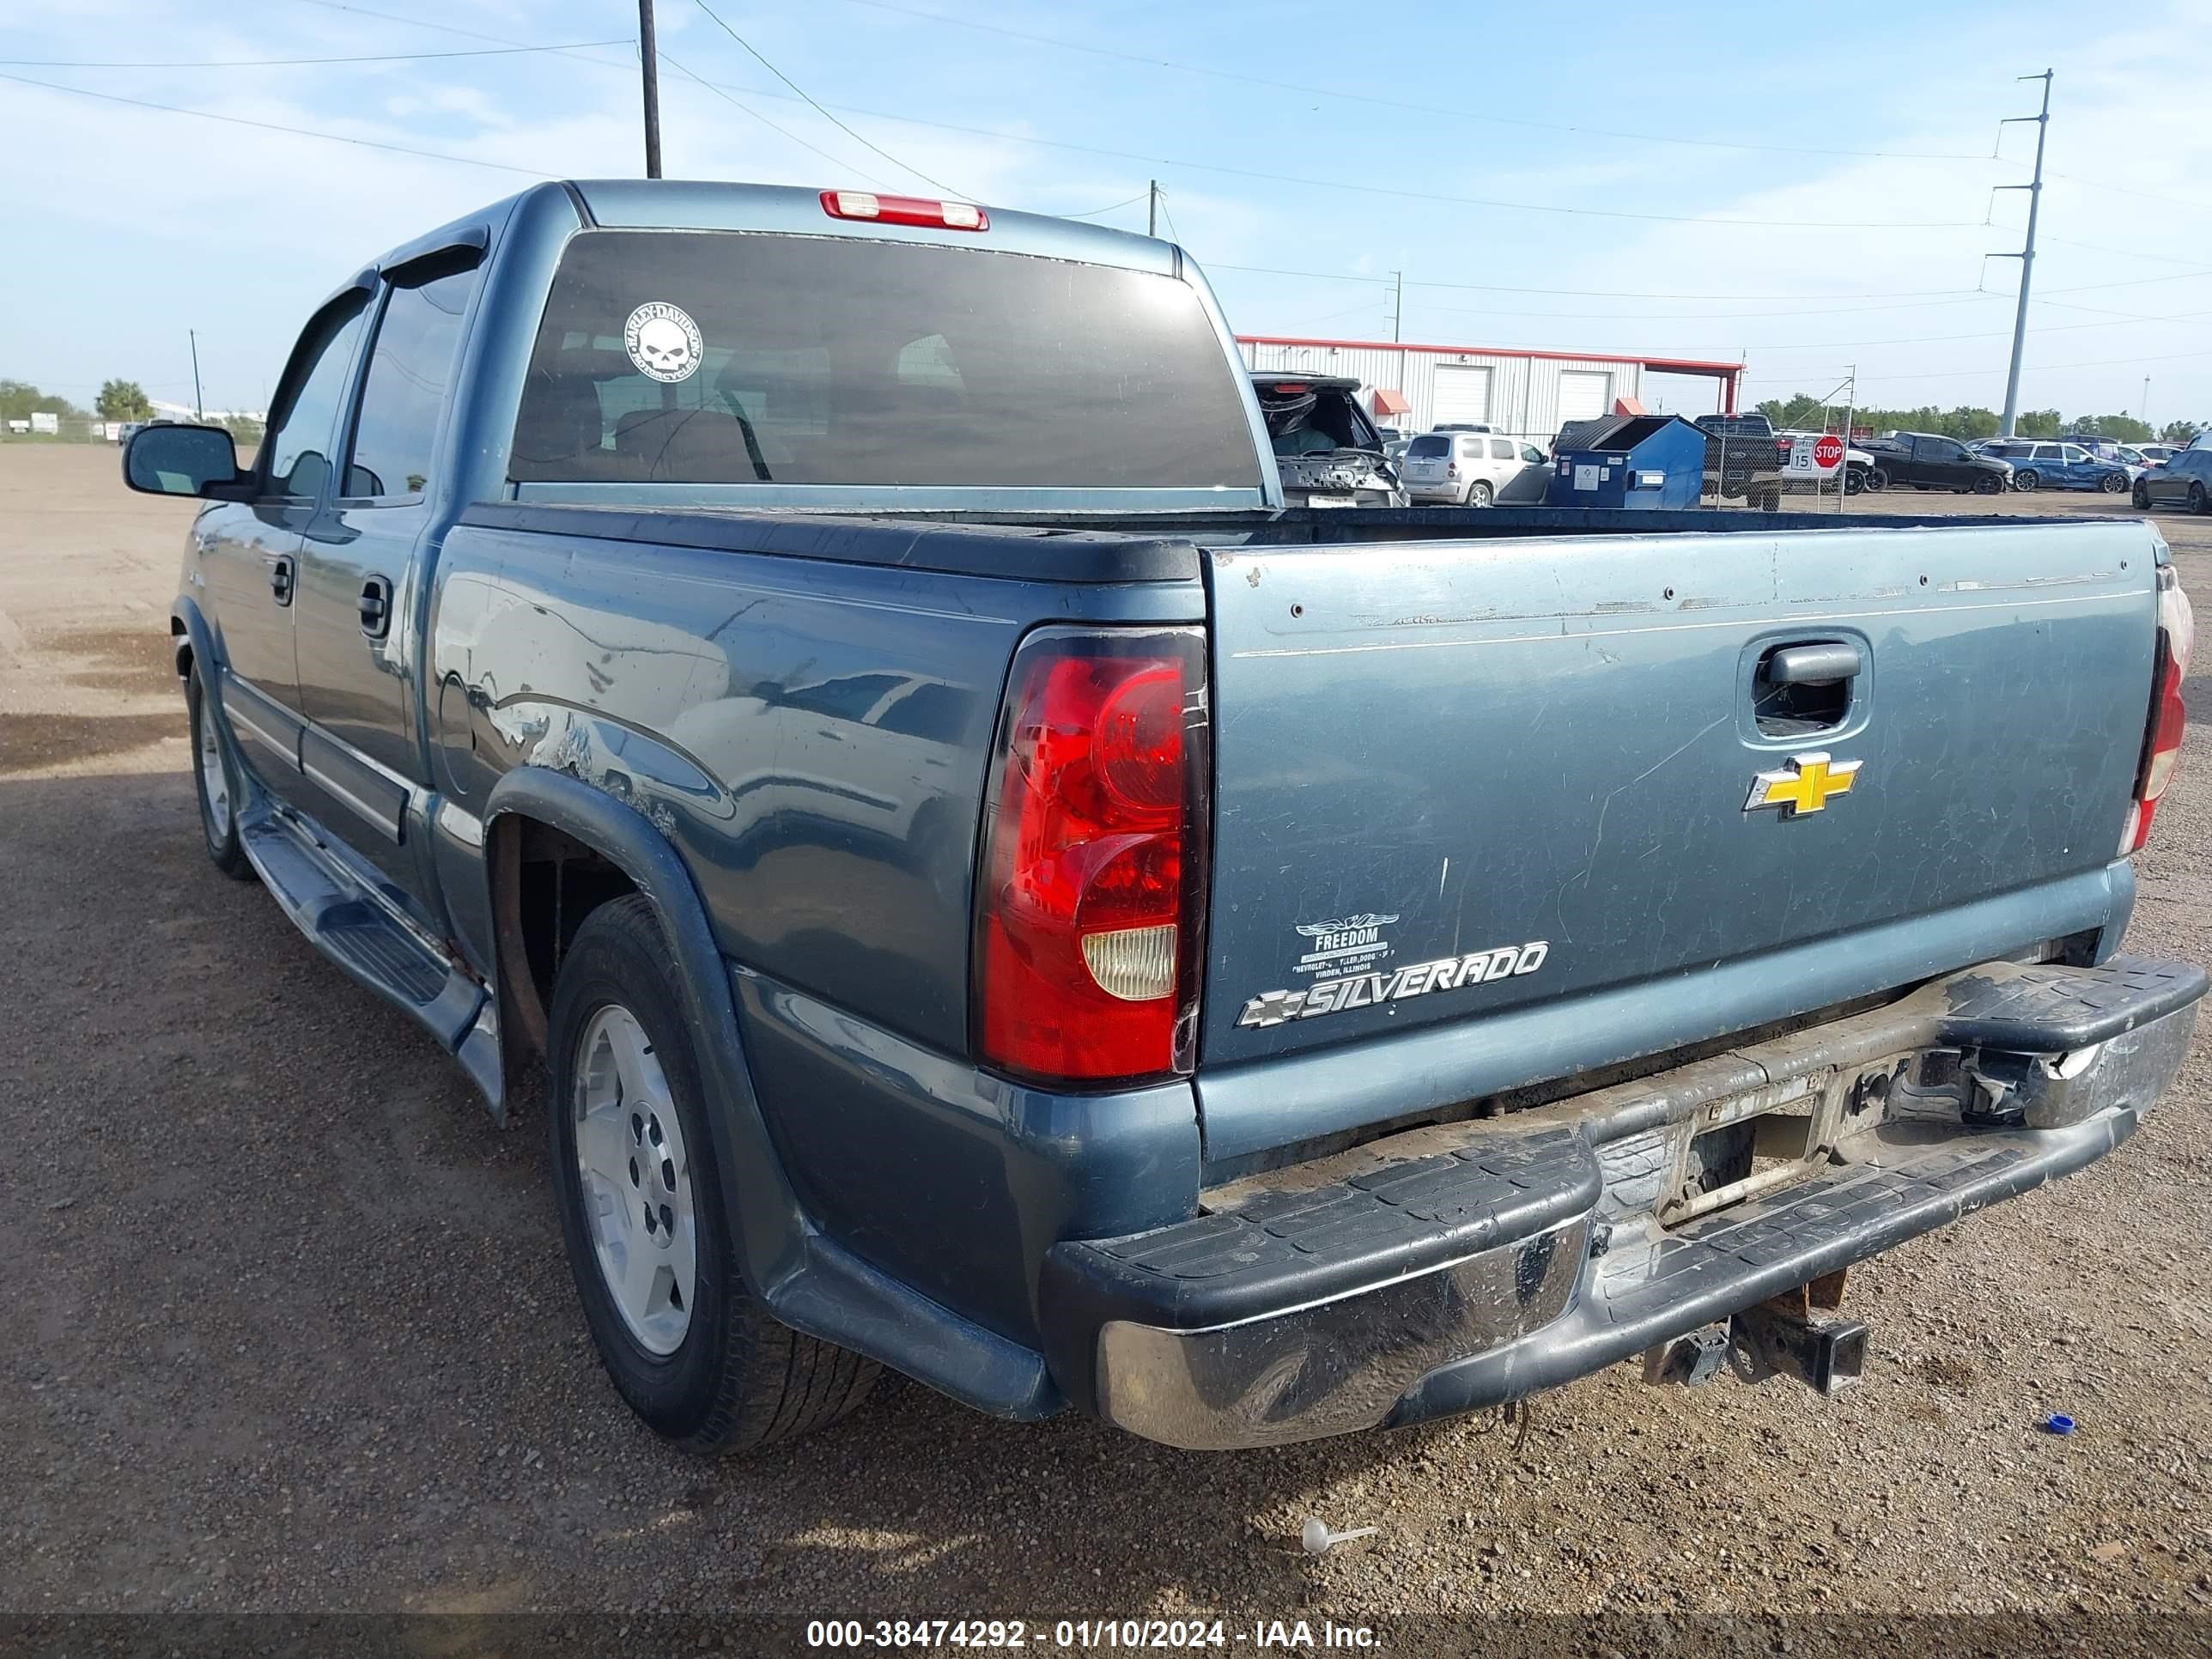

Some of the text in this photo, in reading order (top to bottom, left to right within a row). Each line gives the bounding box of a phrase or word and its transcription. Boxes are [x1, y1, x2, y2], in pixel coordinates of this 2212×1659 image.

[631, 352, 698, 380] MOTORCYCLES
[1796, 455, 1808, 467] 15
[1815, 446, 1842, 459] STOP
[1315, 927, 1379, 951] FREEDOM
[1343, 963, 1371, 975] ILLINOIS
[1300, 942, 1549, 1018] SILVERADO
